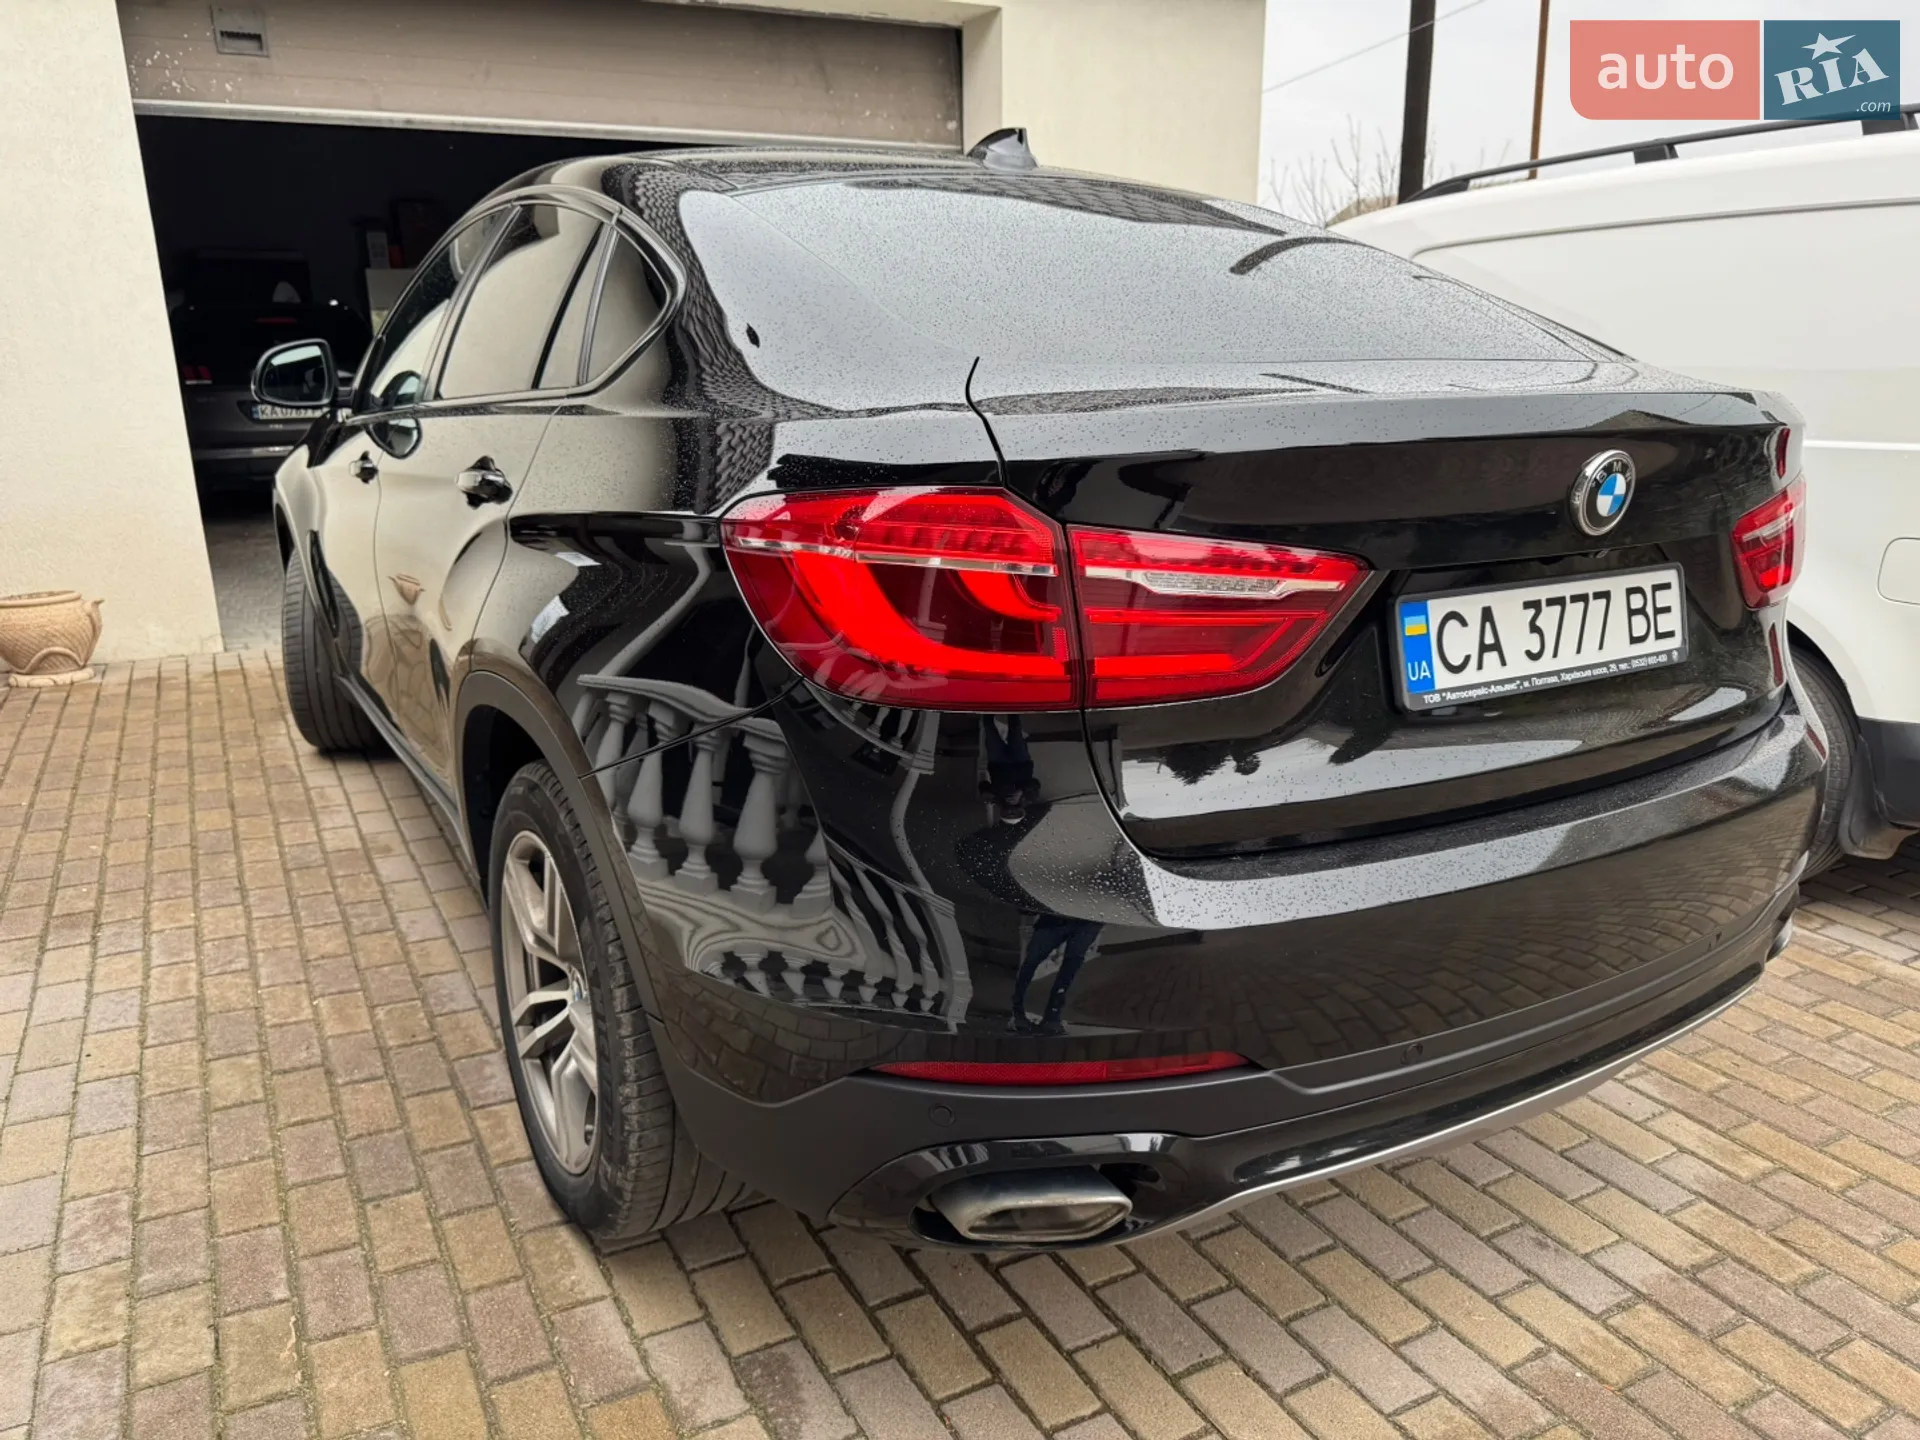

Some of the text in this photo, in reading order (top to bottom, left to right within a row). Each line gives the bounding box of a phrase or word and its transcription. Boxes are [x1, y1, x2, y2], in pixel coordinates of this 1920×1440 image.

[1596, 461, 1632, 483] BMW
[1437, 582, 1676, 674] CA 3777 BE
[1408, 661, 1431, 681] UA
